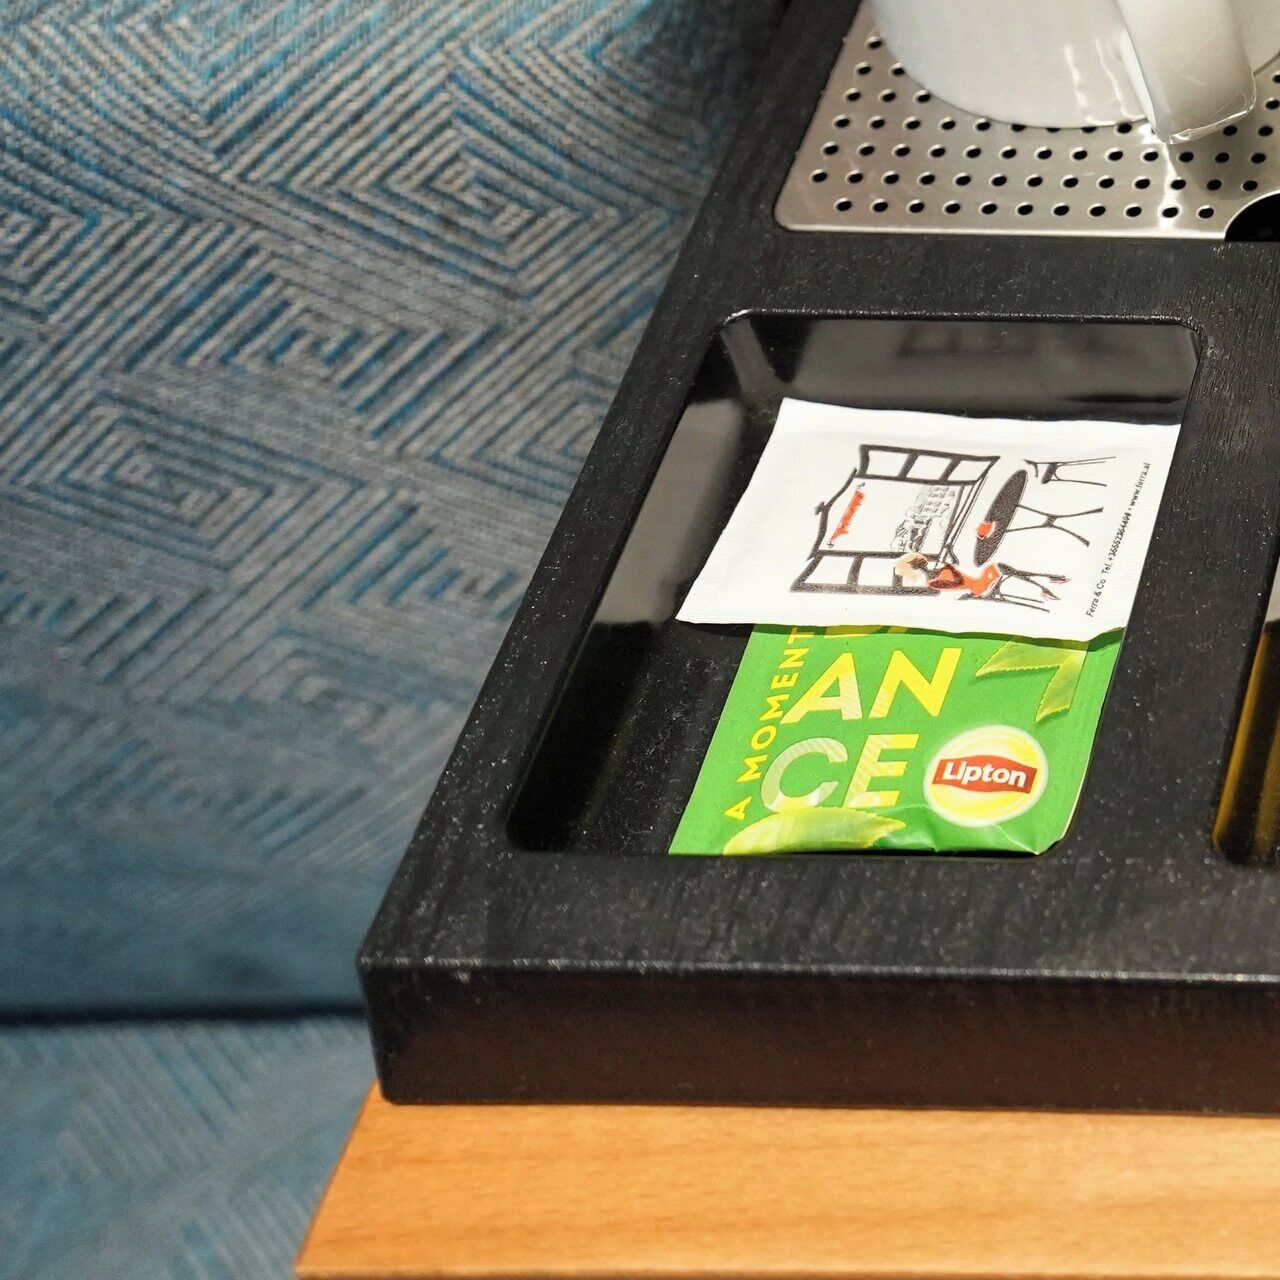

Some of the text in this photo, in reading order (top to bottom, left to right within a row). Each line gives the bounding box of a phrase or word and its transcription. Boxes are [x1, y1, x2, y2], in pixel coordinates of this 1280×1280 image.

[1085, 596, 1100, 618] Ferra
[1096, 578, 1106, 590] Co
[724, 627, 815, 821] A MOMENT
[941, 760, 1027, 788] Lipton
